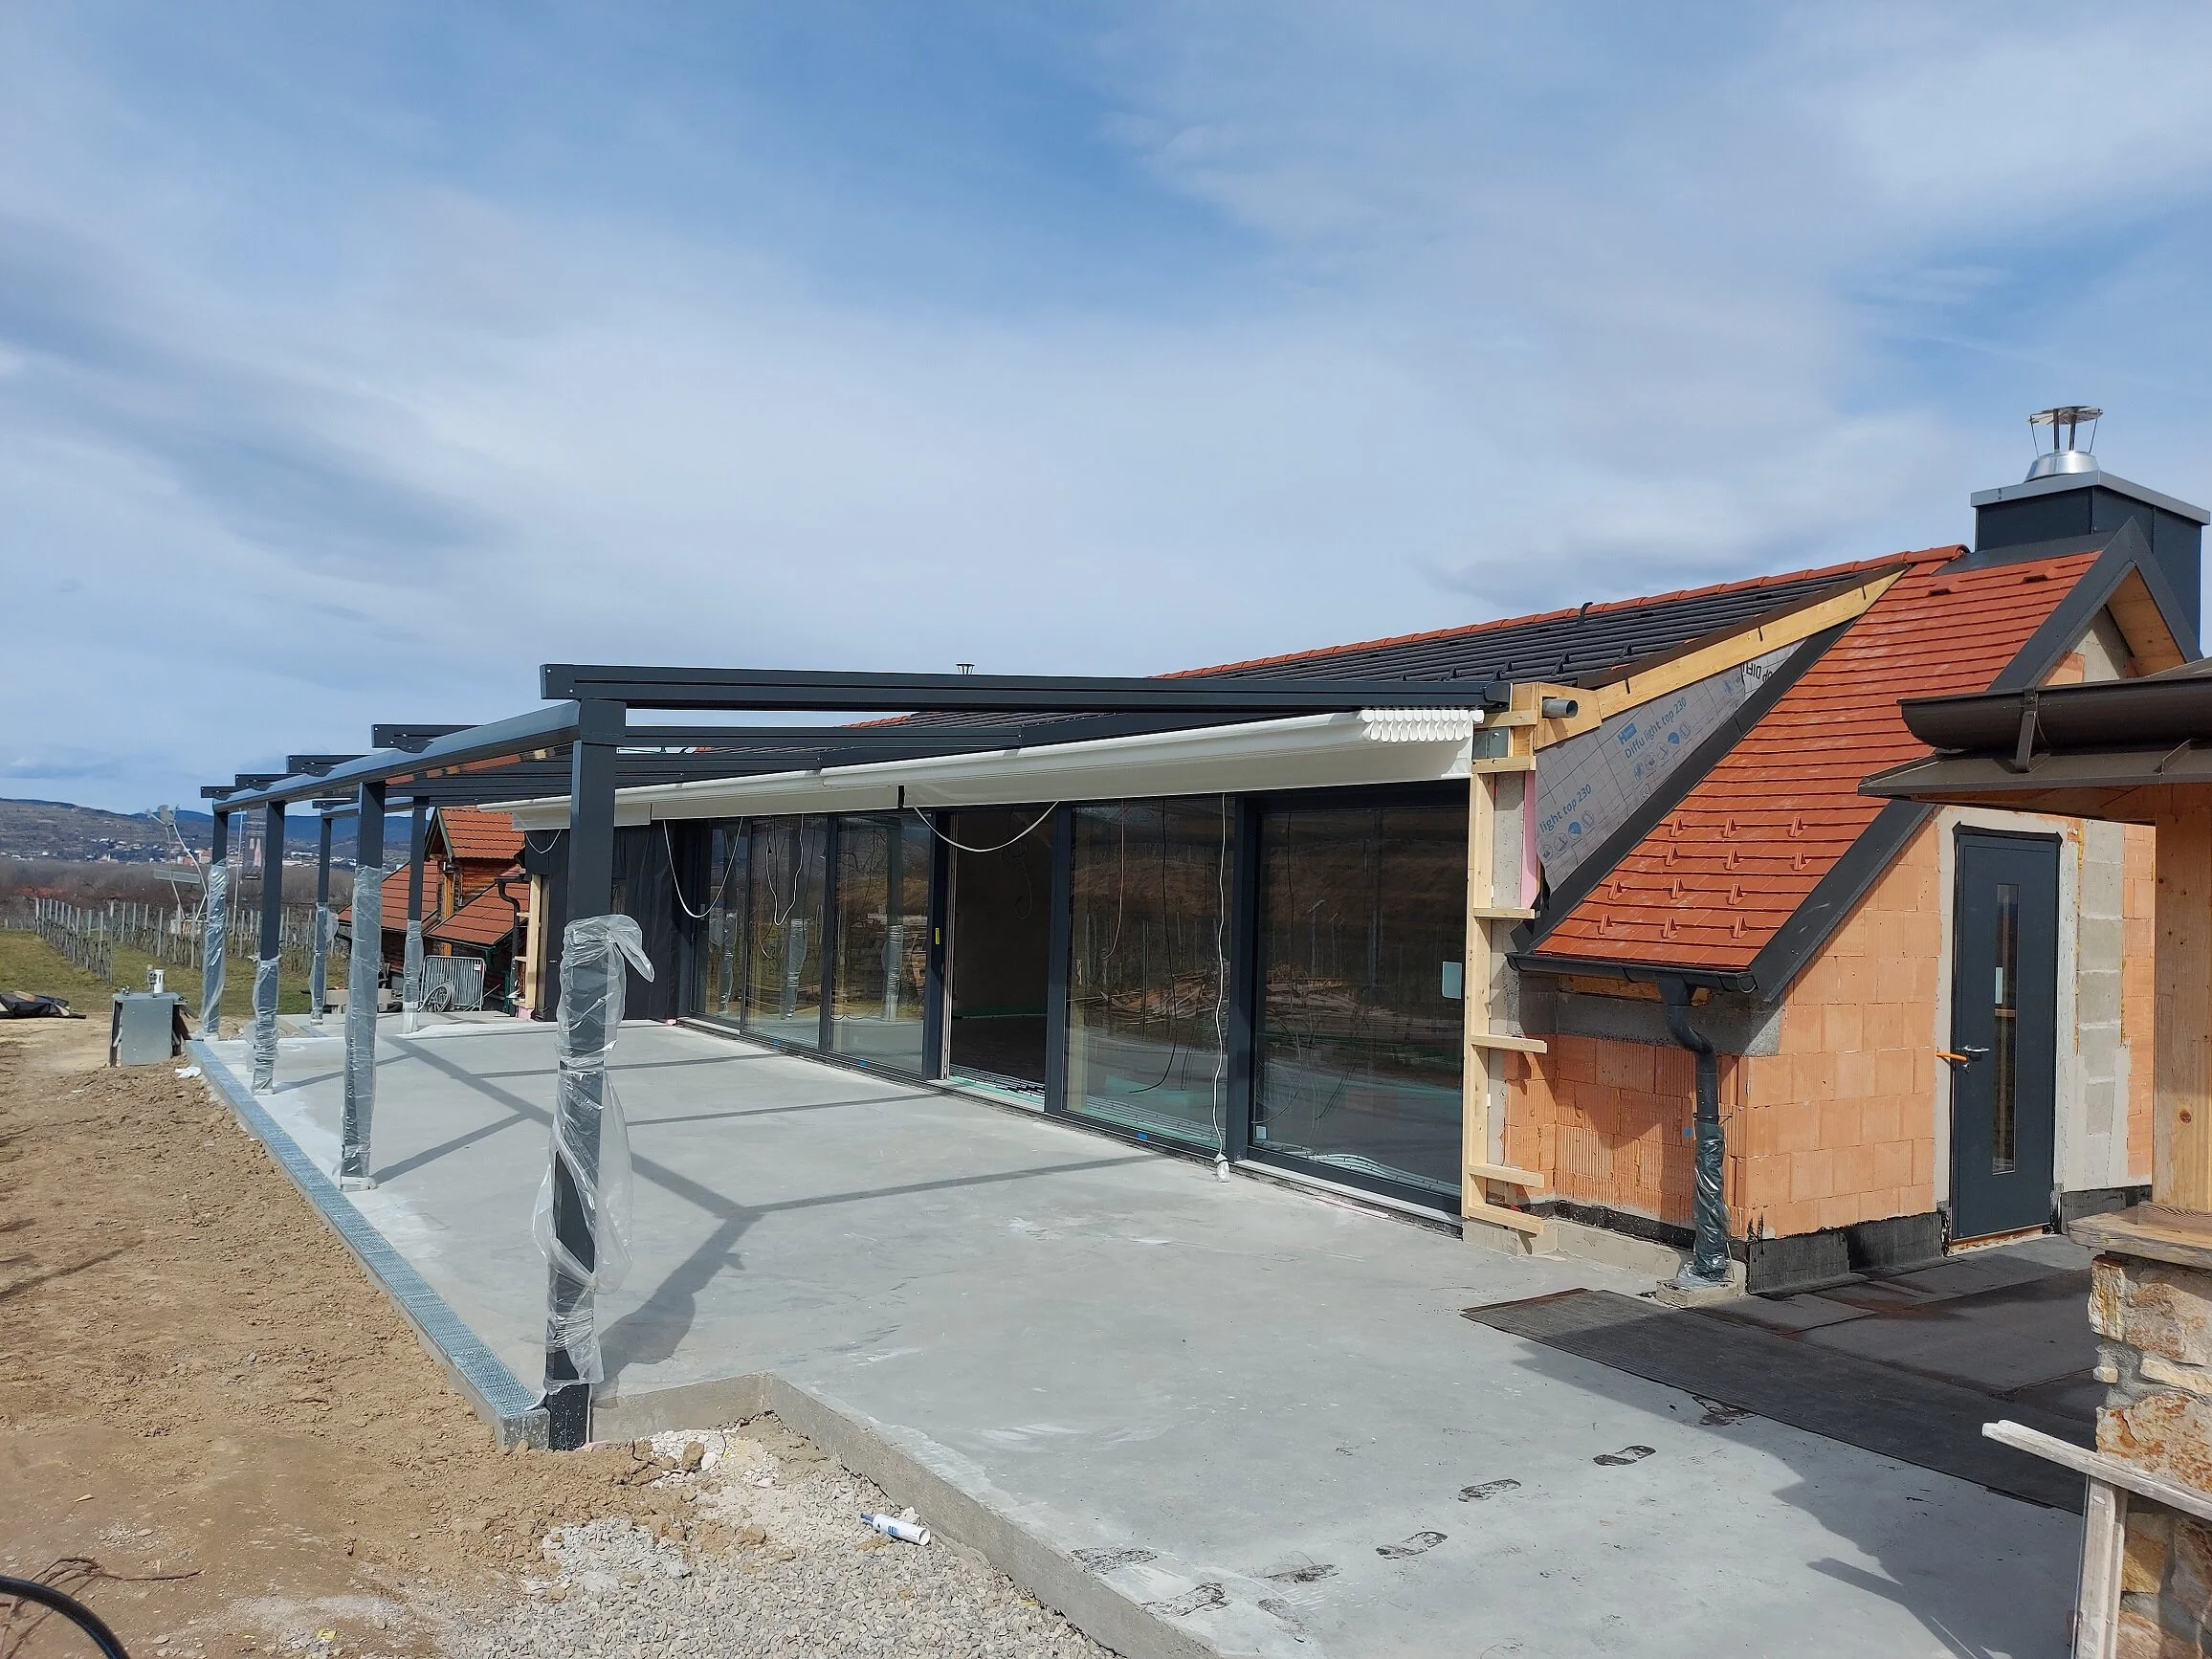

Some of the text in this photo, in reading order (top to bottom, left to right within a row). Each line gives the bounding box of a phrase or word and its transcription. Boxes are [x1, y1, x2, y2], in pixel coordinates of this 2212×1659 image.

[1624, 737, 1645, 759] Diffu
[1643, 721, 1662, 741] light
[1661, 709, 1674, 725] top
[1674, 697, 1687, 714] 230
[1538, 784, 1592, 833] light top 230
